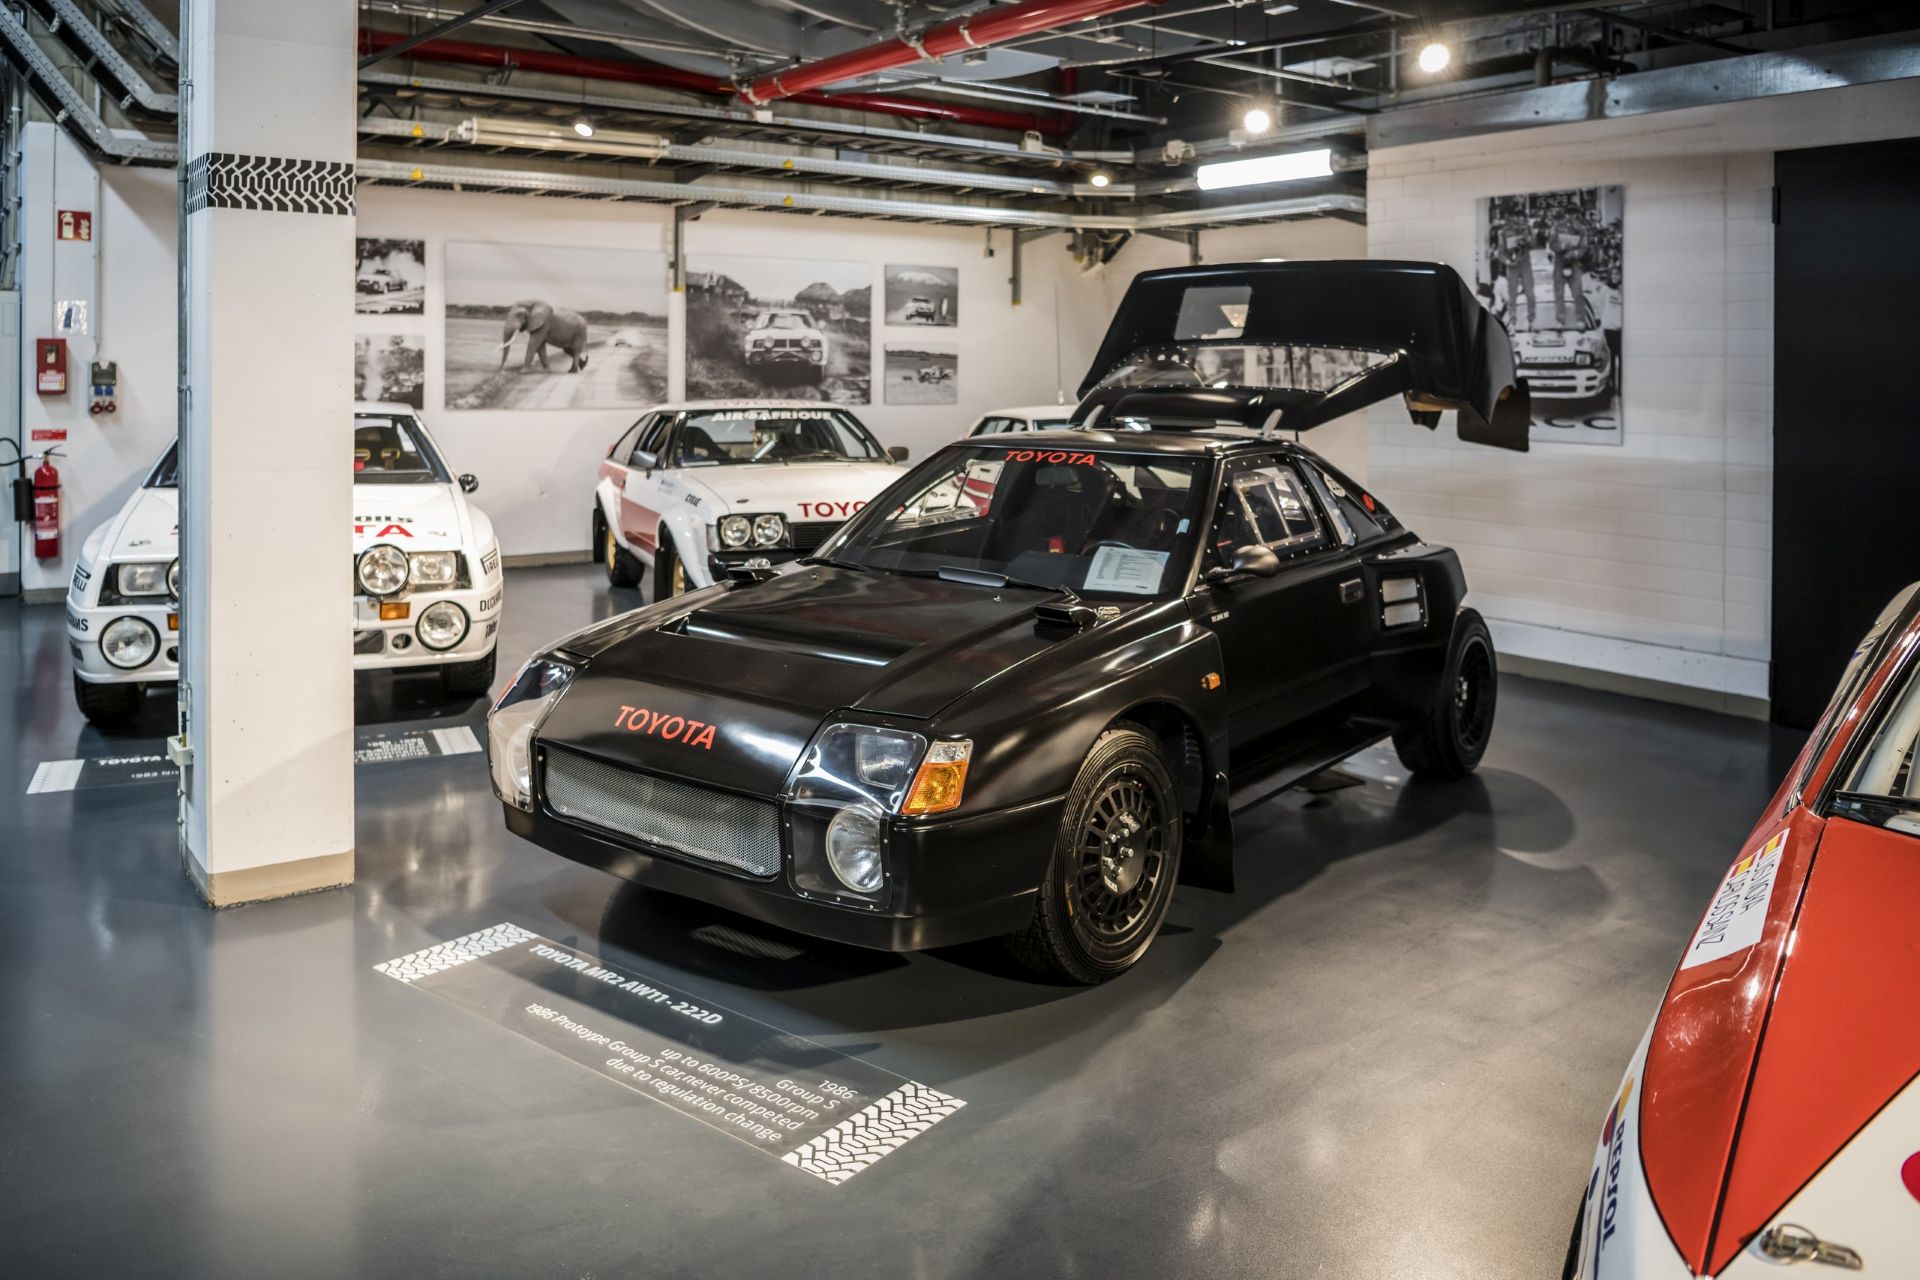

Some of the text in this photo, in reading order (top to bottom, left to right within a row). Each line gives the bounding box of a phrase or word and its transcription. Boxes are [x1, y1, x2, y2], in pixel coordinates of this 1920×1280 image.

[759, 410, 832, 421] AFRIQUE
[1004, 450, 1096, 467] TOYOTA
[613, 705, 717, 751] TOYOTA
[98, 754, 162, 766] TOYOTA
[1695, 870, 1750, 950] CARLOS SAINZ
[529, 943, 590, 972] TOYOTA
[585, 965, 626, 986] MR2
[617, 979, 670, 1004] AW11
[671, 1001, 724, 1025] 222D
[525, 1002, 559, 1020] 1986
[551, 1014, 611, 1046] Protoype
[608, 1040, 652, 1064] Group
[648, 1058, 666, 1069] S
[723, 1092, 805, 1131] competed
[660, 1048, 683, 1061] up
[681, 1055, 700, 1068] to
[605, 1057, 783, 1142] due to regulation change
[776, 1079, 841, 1110] Group S
[818, 1079, 858, 1100] 1986
[1602, 1118, 1626, 1251] REPSOL
